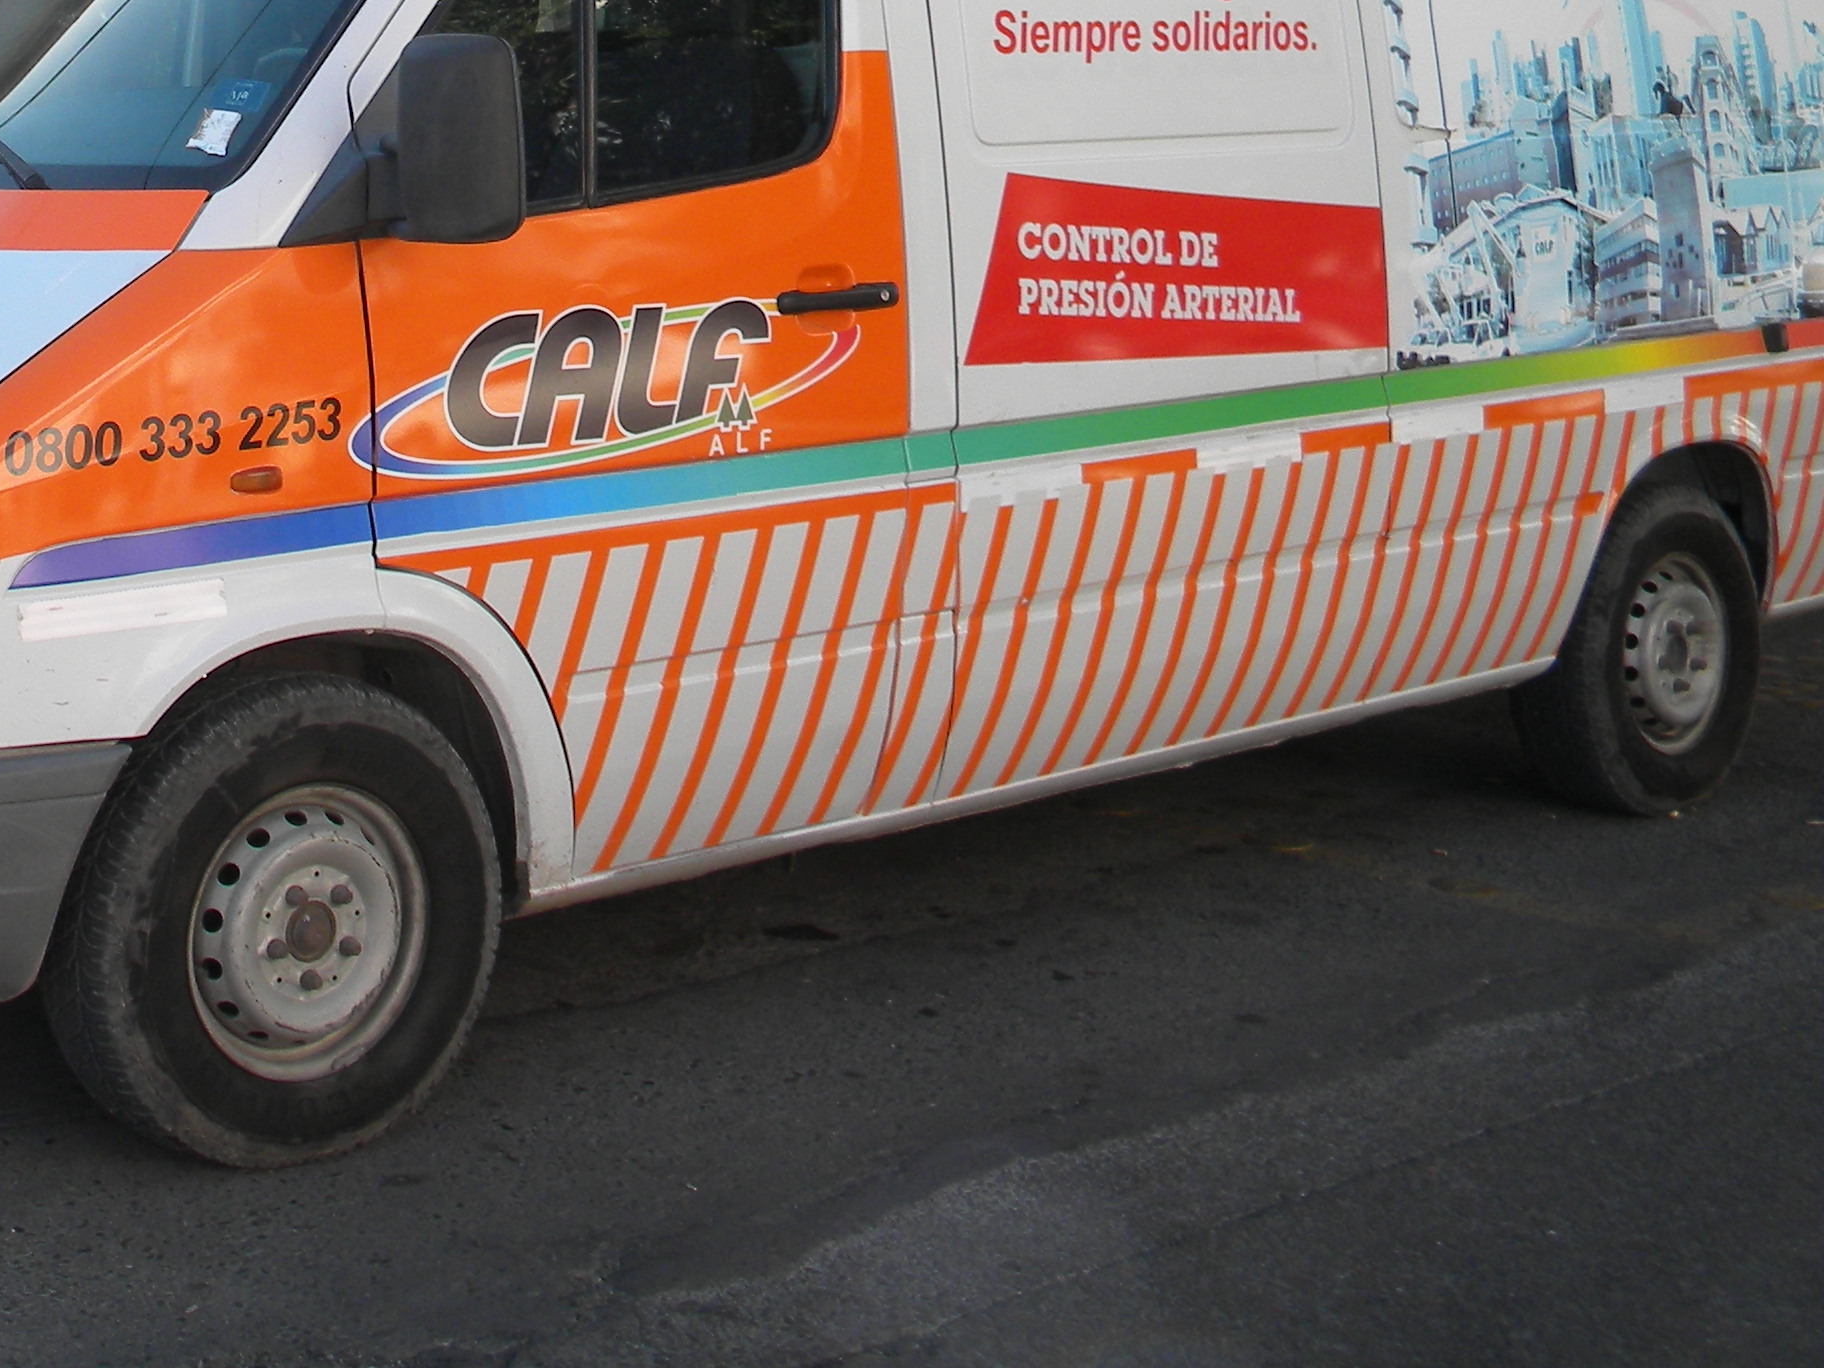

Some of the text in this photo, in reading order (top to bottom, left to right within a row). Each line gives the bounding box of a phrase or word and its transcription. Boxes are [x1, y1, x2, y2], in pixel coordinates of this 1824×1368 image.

[993, 10, 1317, 63] Siempre solidarios.
[1017, 223, 1218, 268] CONTROL DE
[1018, 272, 1300, 323] PRESIÓN ARTERIAL
[444, 299, 771, 447] CALF
[4, 396, 343, 479] 0800 333 2253
[707, 425, 773, 457] ALF
